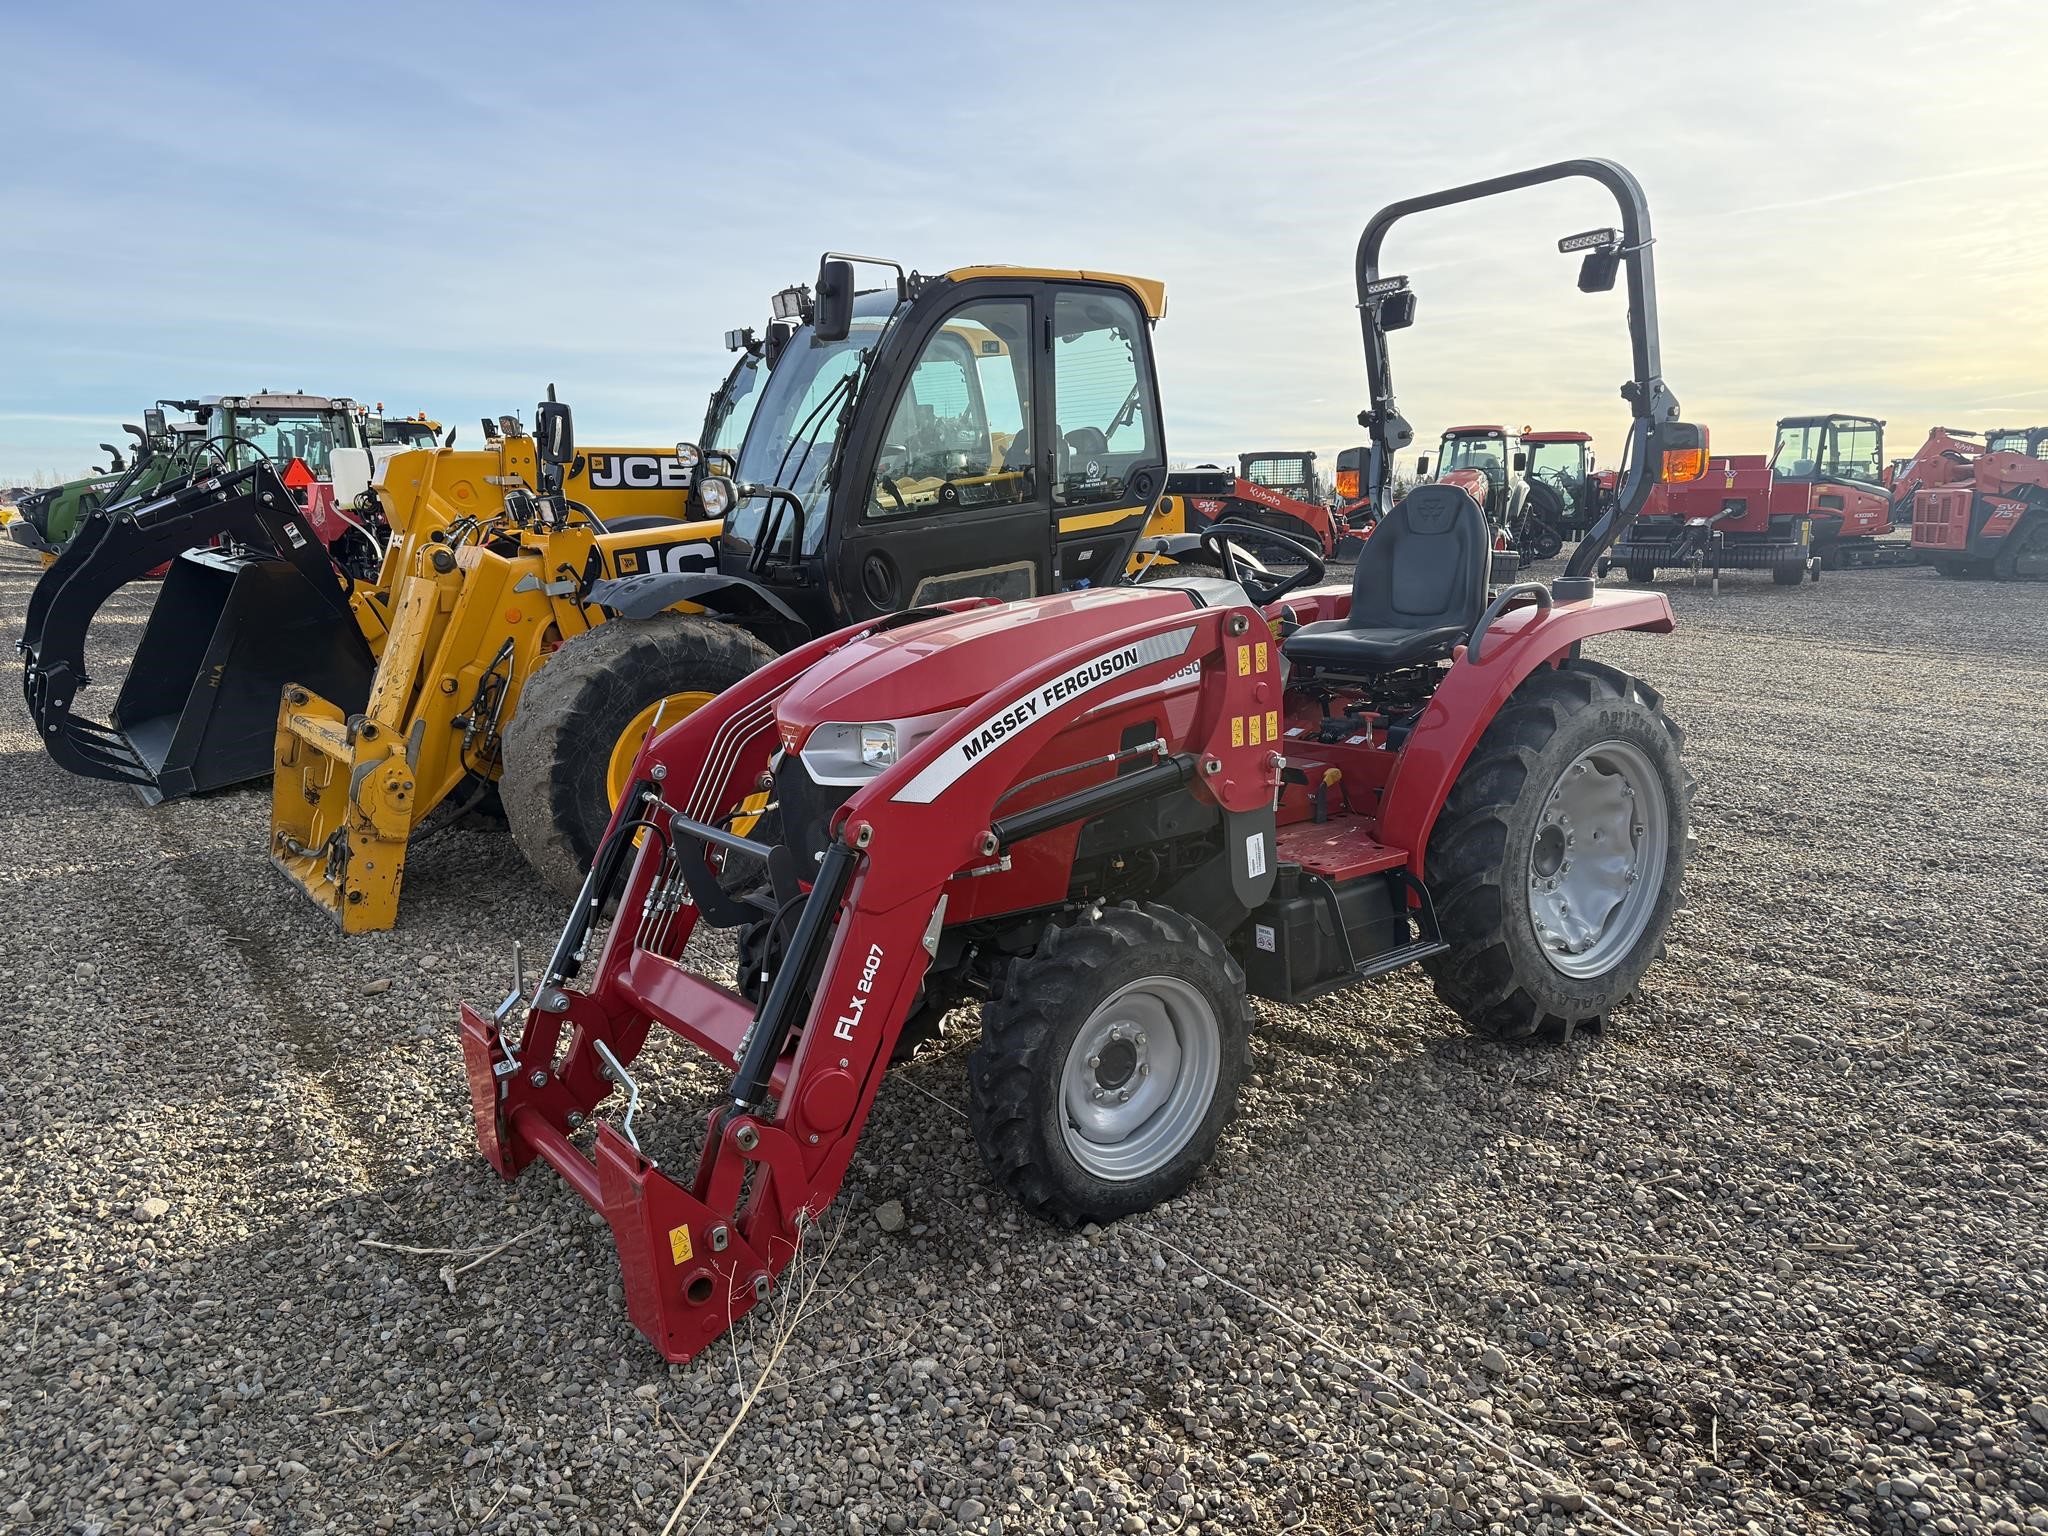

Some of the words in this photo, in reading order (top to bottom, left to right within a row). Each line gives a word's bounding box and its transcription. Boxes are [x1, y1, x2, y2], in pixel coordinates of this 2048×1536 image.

[592, 457, 693, 487] JCB
[1249, 486, 1281, 506] Kubota
[646, 543, 720, 574] JC
[962, 697, 1037, 761] MASSEY
[1042, 648, 1138, 707] FERGUSON
[833, 995, 867, 1041] FLX
[857, 943, 884, 993] 2407
